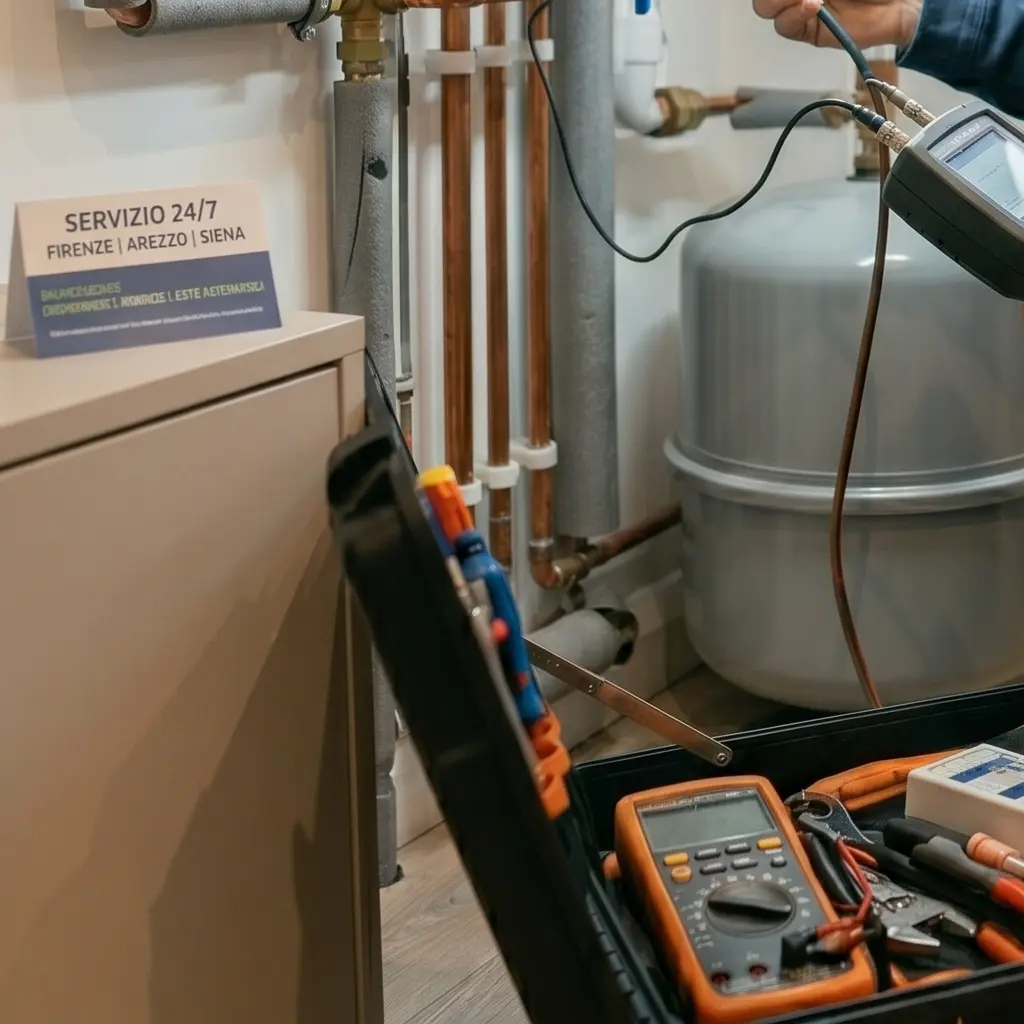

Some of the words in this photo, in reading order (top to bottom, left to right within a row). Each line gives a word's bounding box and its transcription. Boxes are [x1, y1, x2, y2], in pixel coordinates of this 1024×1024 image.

[65, 205, 165, 233] SERVIZIO
[171, 198, 218, 223] 24/7
[46, 239, 114, 260] FIRENZE
[126, 232, 188, 252] AREZZO
[200, 226, 246, 244] SIENA
